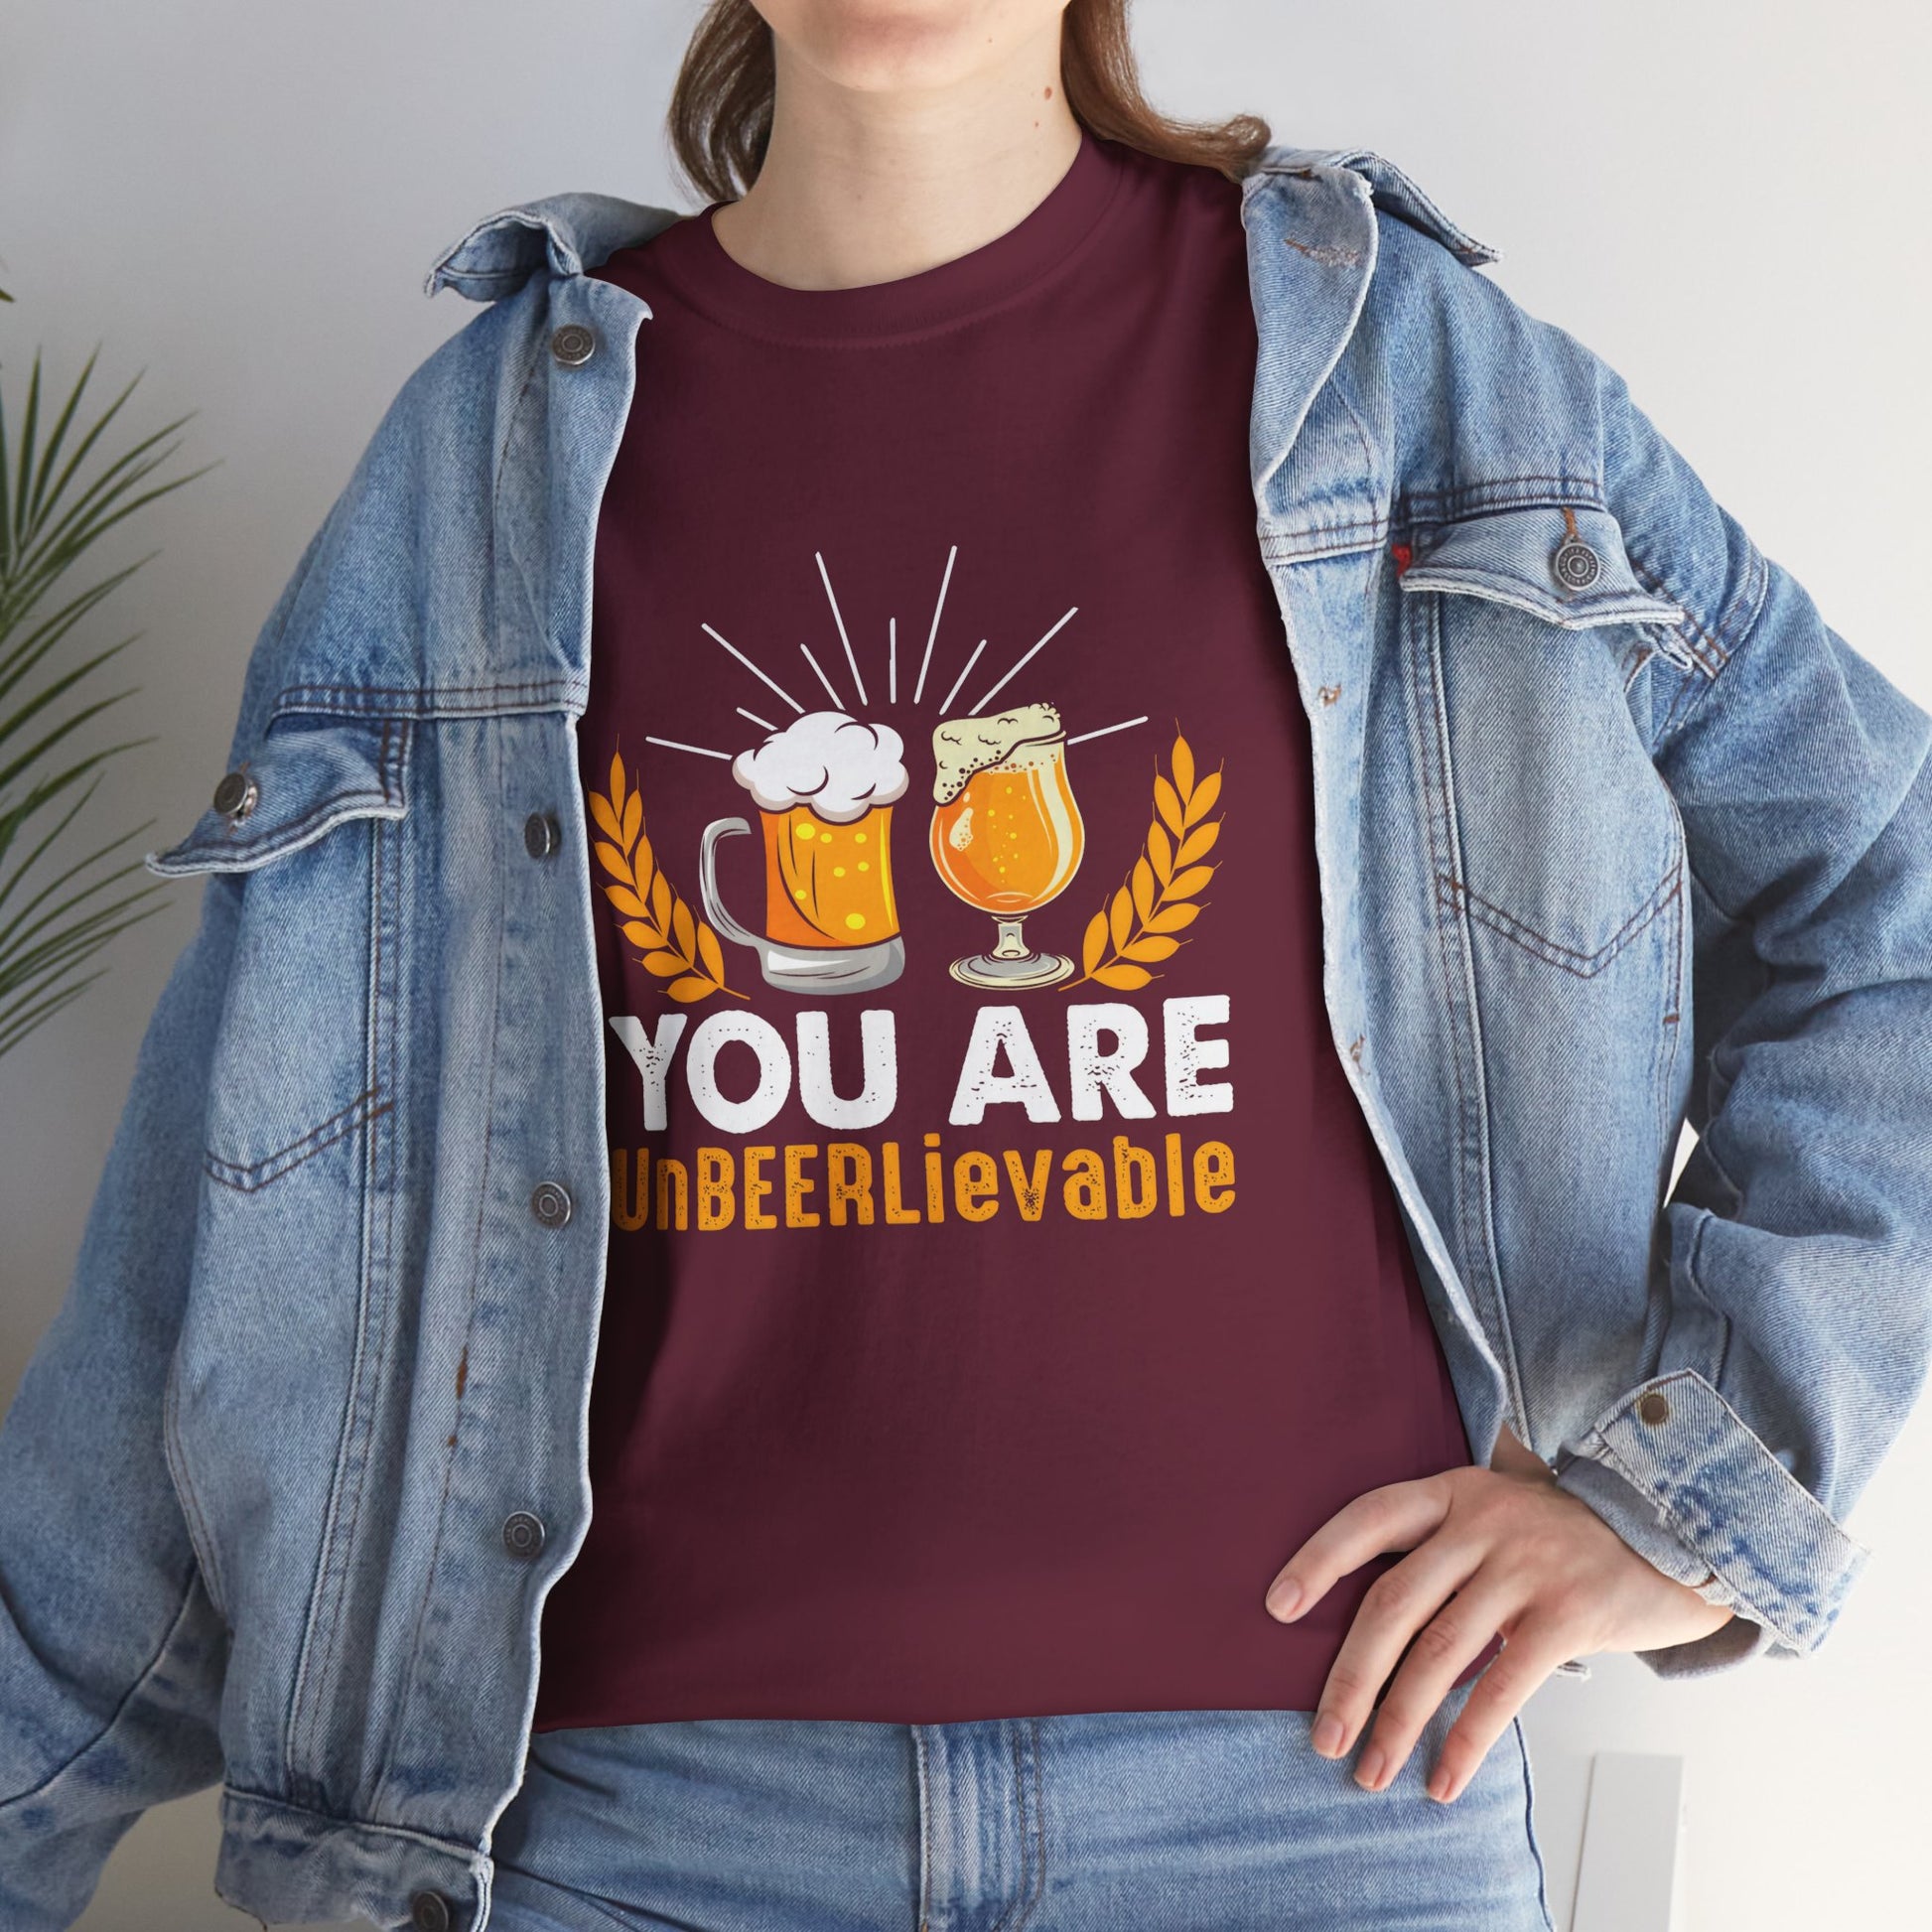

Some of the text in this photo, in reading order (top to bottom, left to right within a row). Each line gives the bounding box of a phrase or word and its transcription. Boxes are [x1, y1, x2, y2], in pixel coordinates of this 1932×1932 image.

[609, 995, 1234, 1134] YOU ARE
[612, 1133, 1236, 1231] UnBEERLievable
